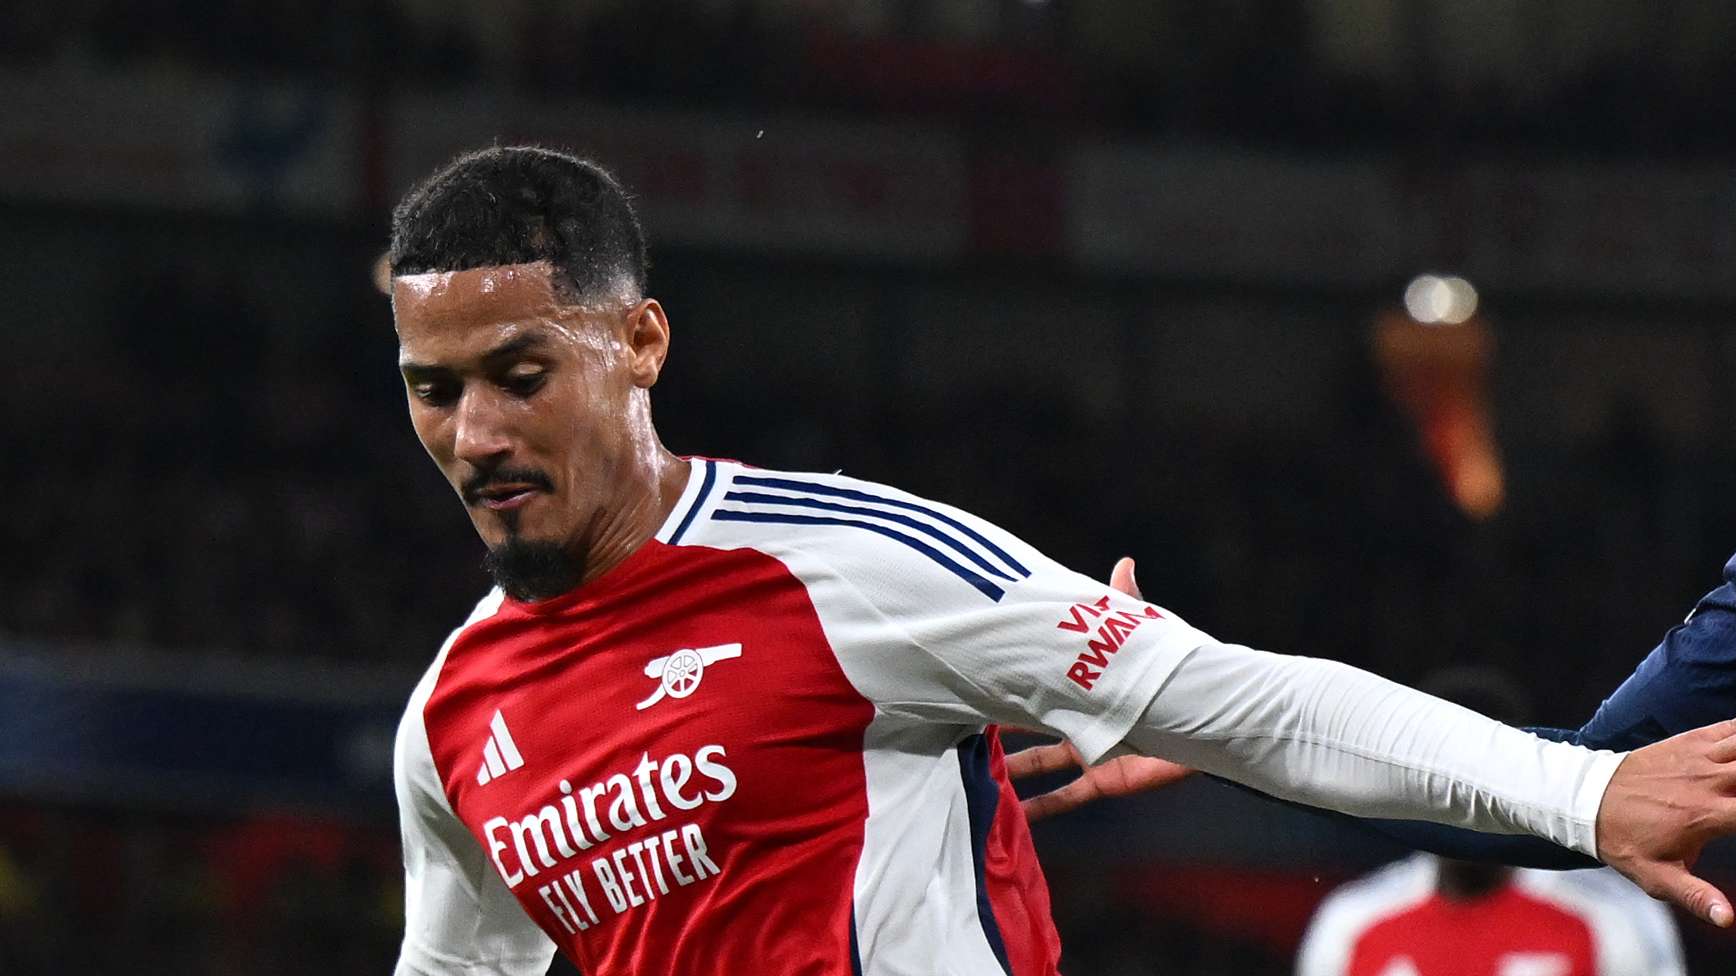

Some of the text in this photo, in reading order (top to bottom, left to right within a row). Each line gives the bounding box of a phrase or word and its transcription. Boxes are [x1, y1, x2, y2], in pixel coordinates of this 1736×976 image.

[483, 744, 738, 890] Emirates
[538, 823, 721, 936] FLY BETTER
